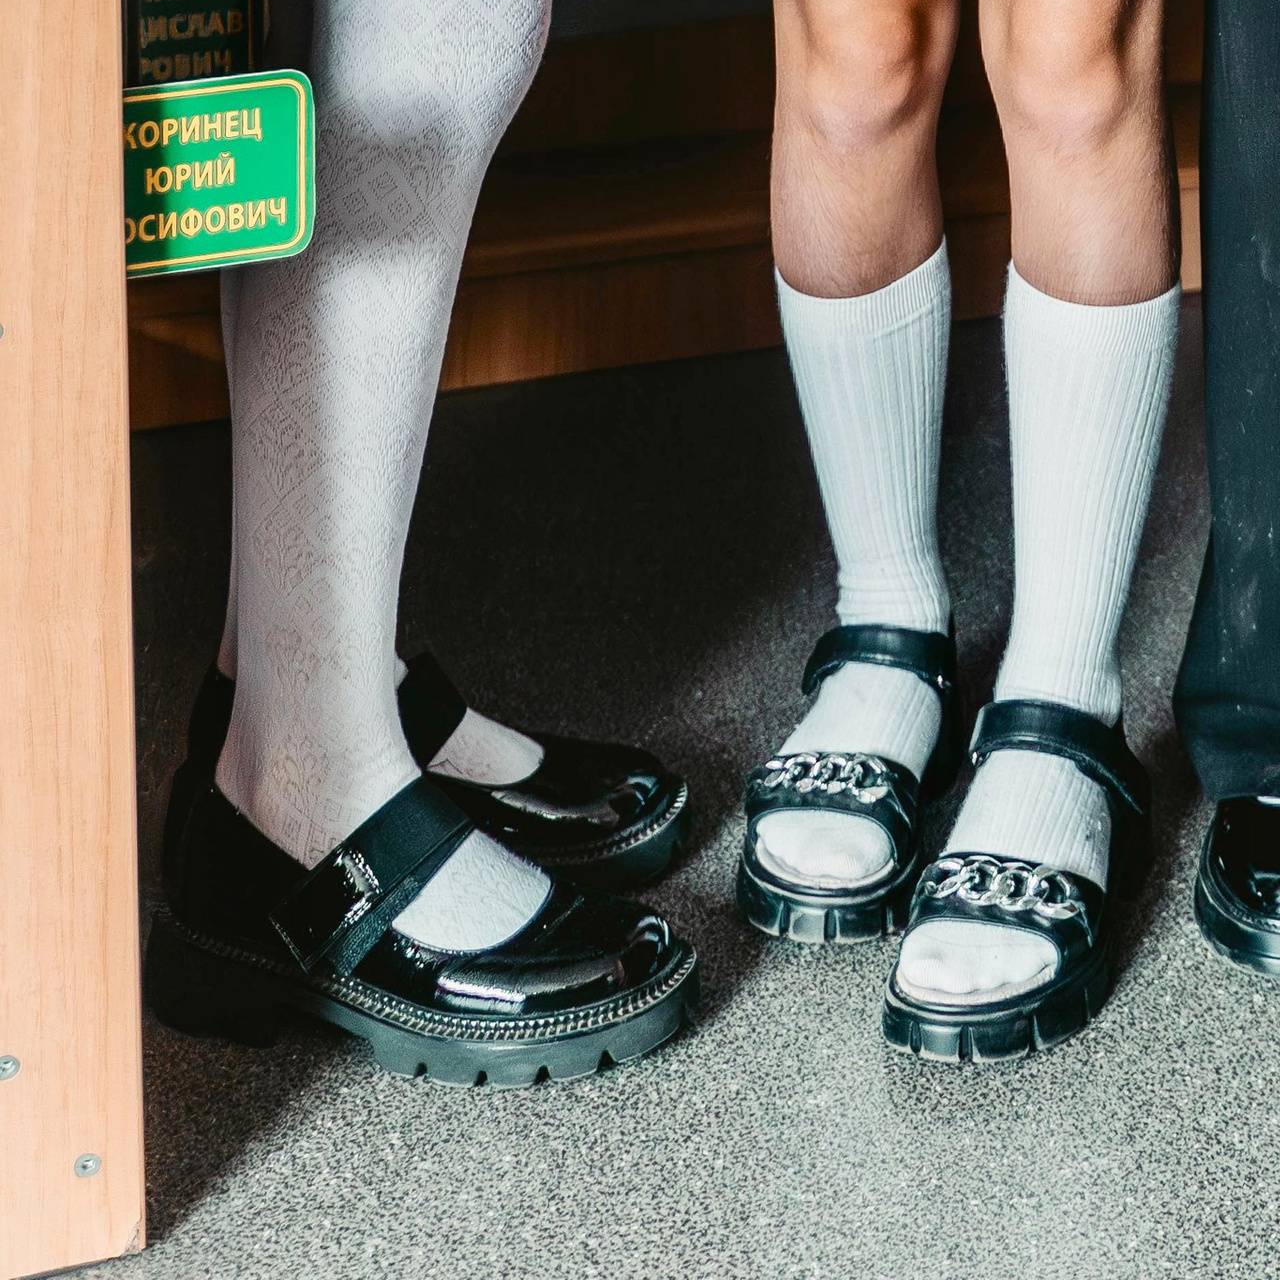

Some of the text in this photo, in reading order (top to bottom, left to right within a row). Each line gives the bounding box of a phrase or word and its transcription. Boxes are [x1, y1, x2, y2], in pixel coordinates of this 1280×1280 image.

[123, 106, 263, 150] КОРИНЕЦ
[145, 152, 237, 195] ЮРИЙ
[124, 196, 288, 245] ОСИФОВИЧ
